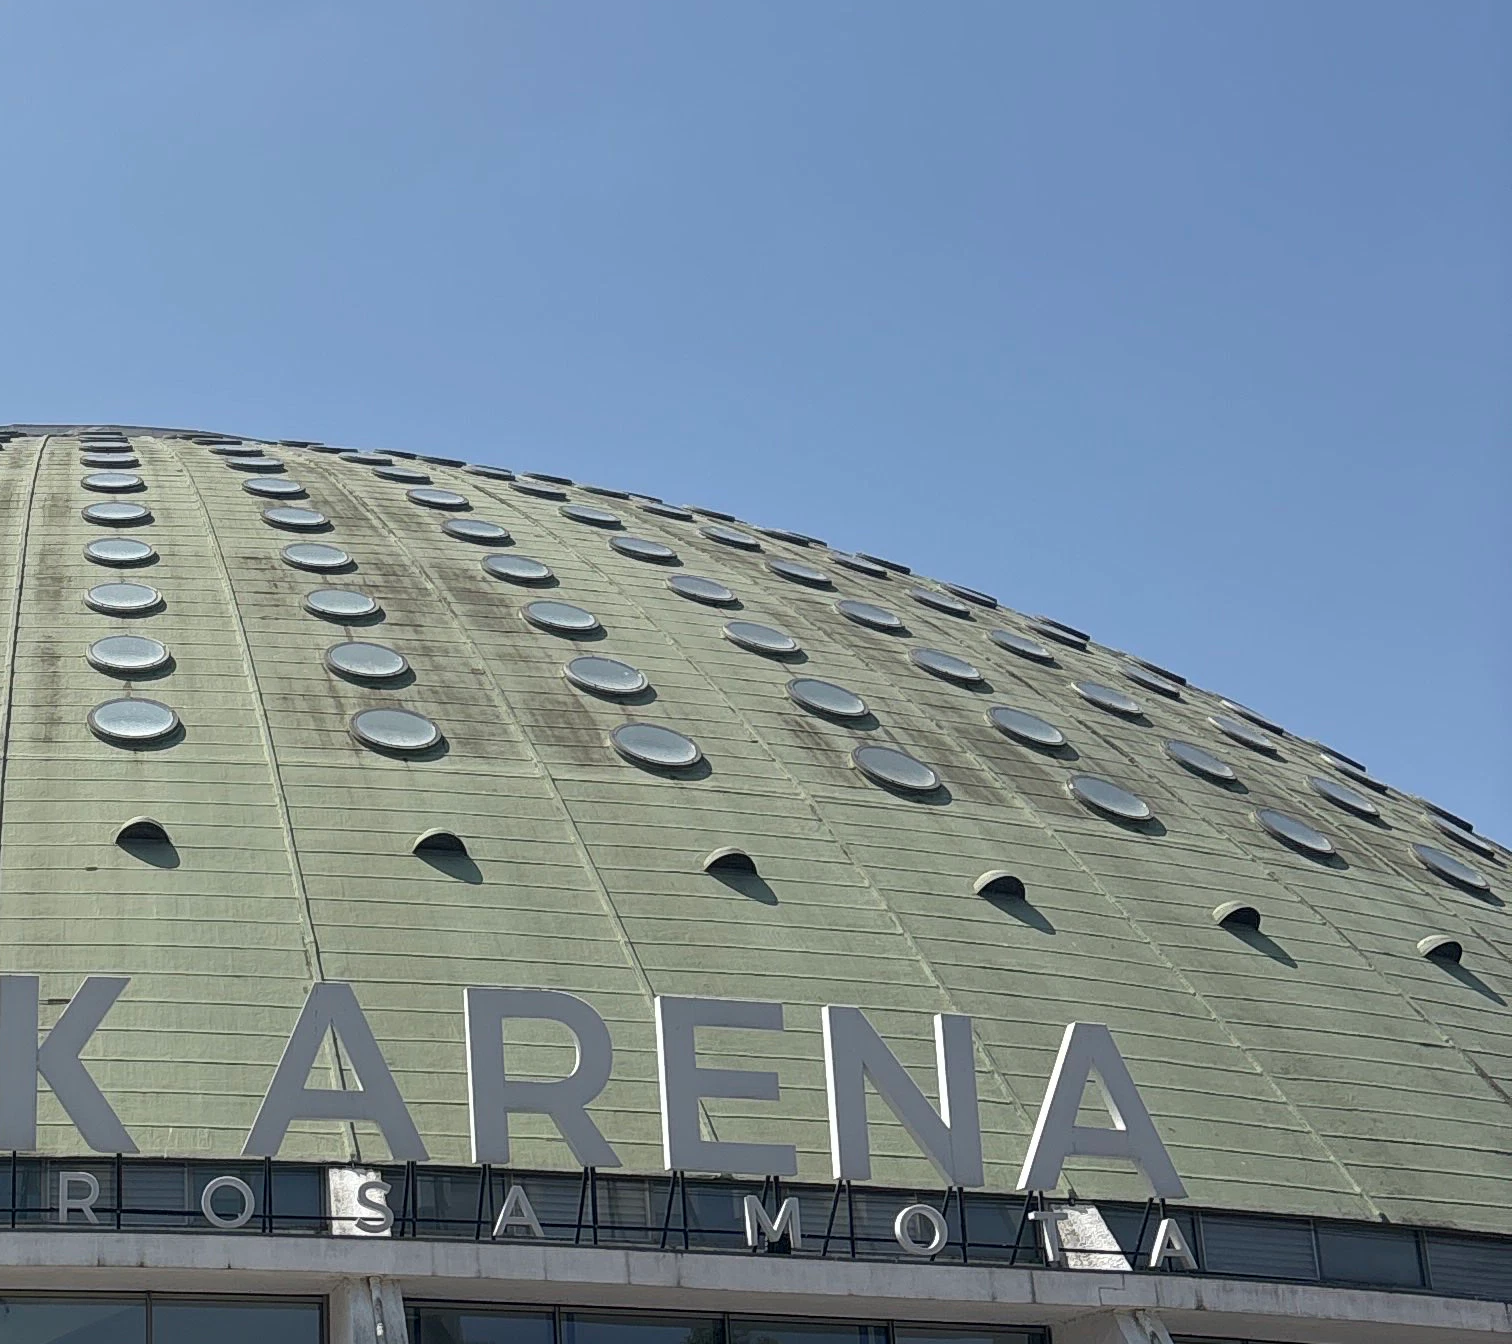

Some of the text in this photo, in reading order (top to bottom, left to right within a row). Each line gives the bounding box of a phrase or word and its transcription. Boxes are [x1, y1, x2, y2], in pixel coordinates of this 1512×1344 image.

[240, 982, 1188, 1199] ARENA
[58, 1170, 544, 1238] ROSA
[743, 1195, 1198, 1270] MOTA
